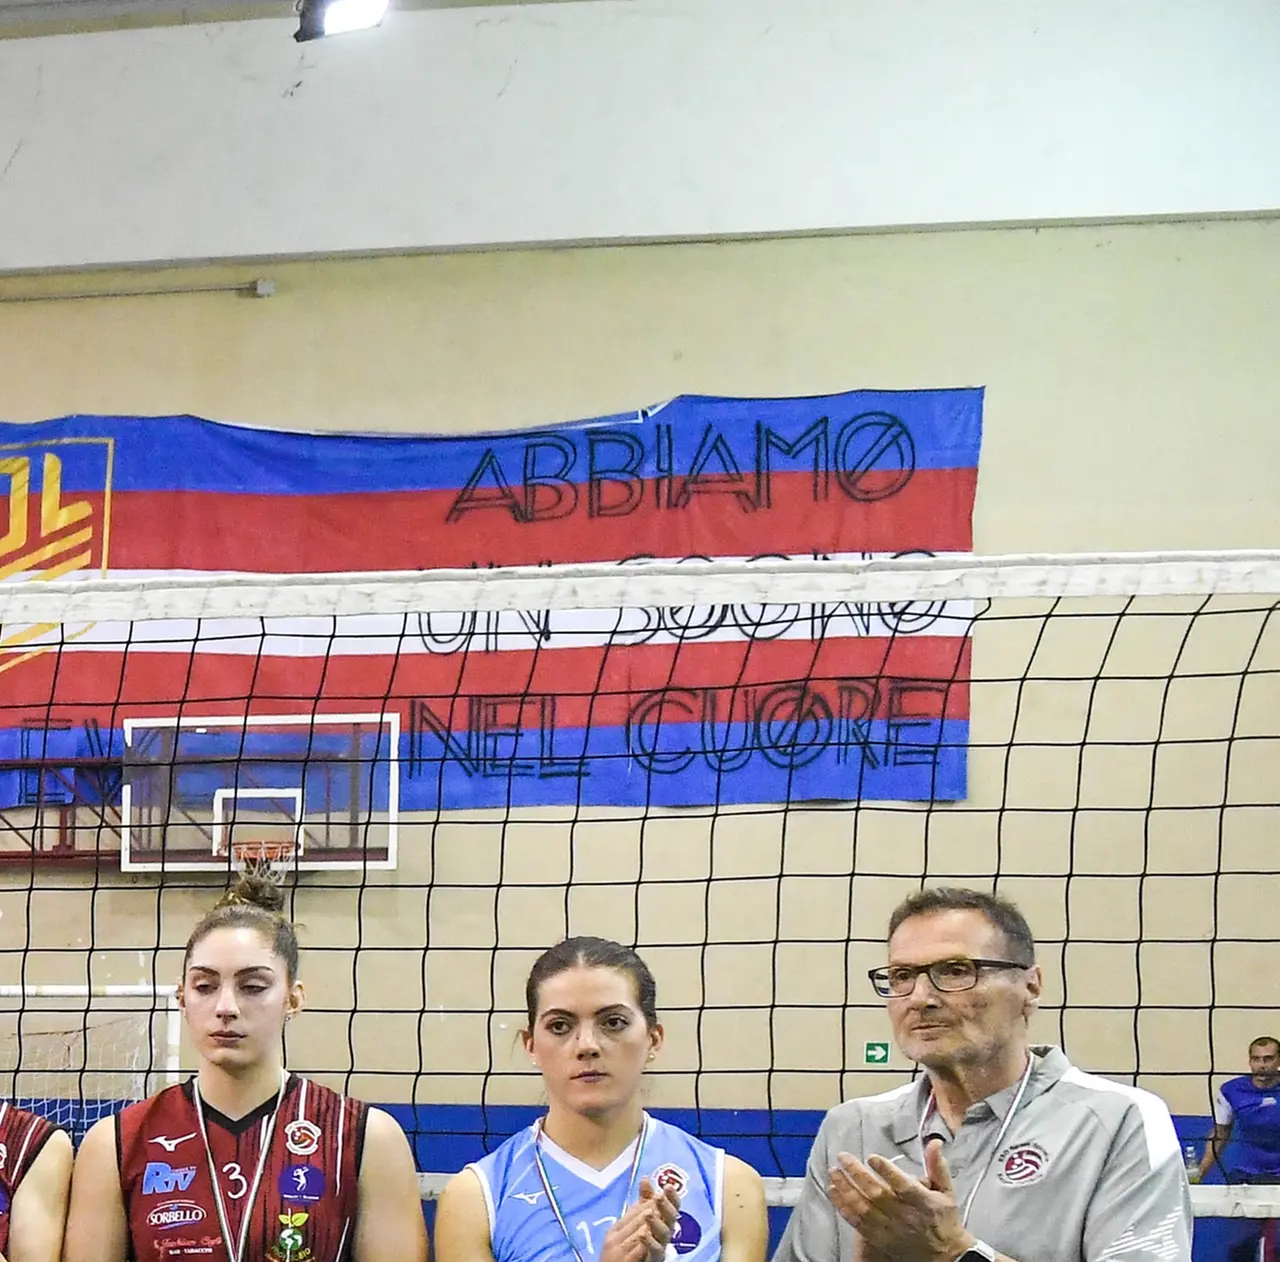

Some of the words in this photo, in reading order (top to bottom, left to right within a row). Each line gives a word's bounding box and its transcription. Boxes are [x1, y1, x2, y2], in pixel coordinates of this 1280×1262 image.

[407, 690, 591, 780] NEL
[222, 1162, 247, 1199] 3
[149, 1209, 203, 1225] SORBELLO
